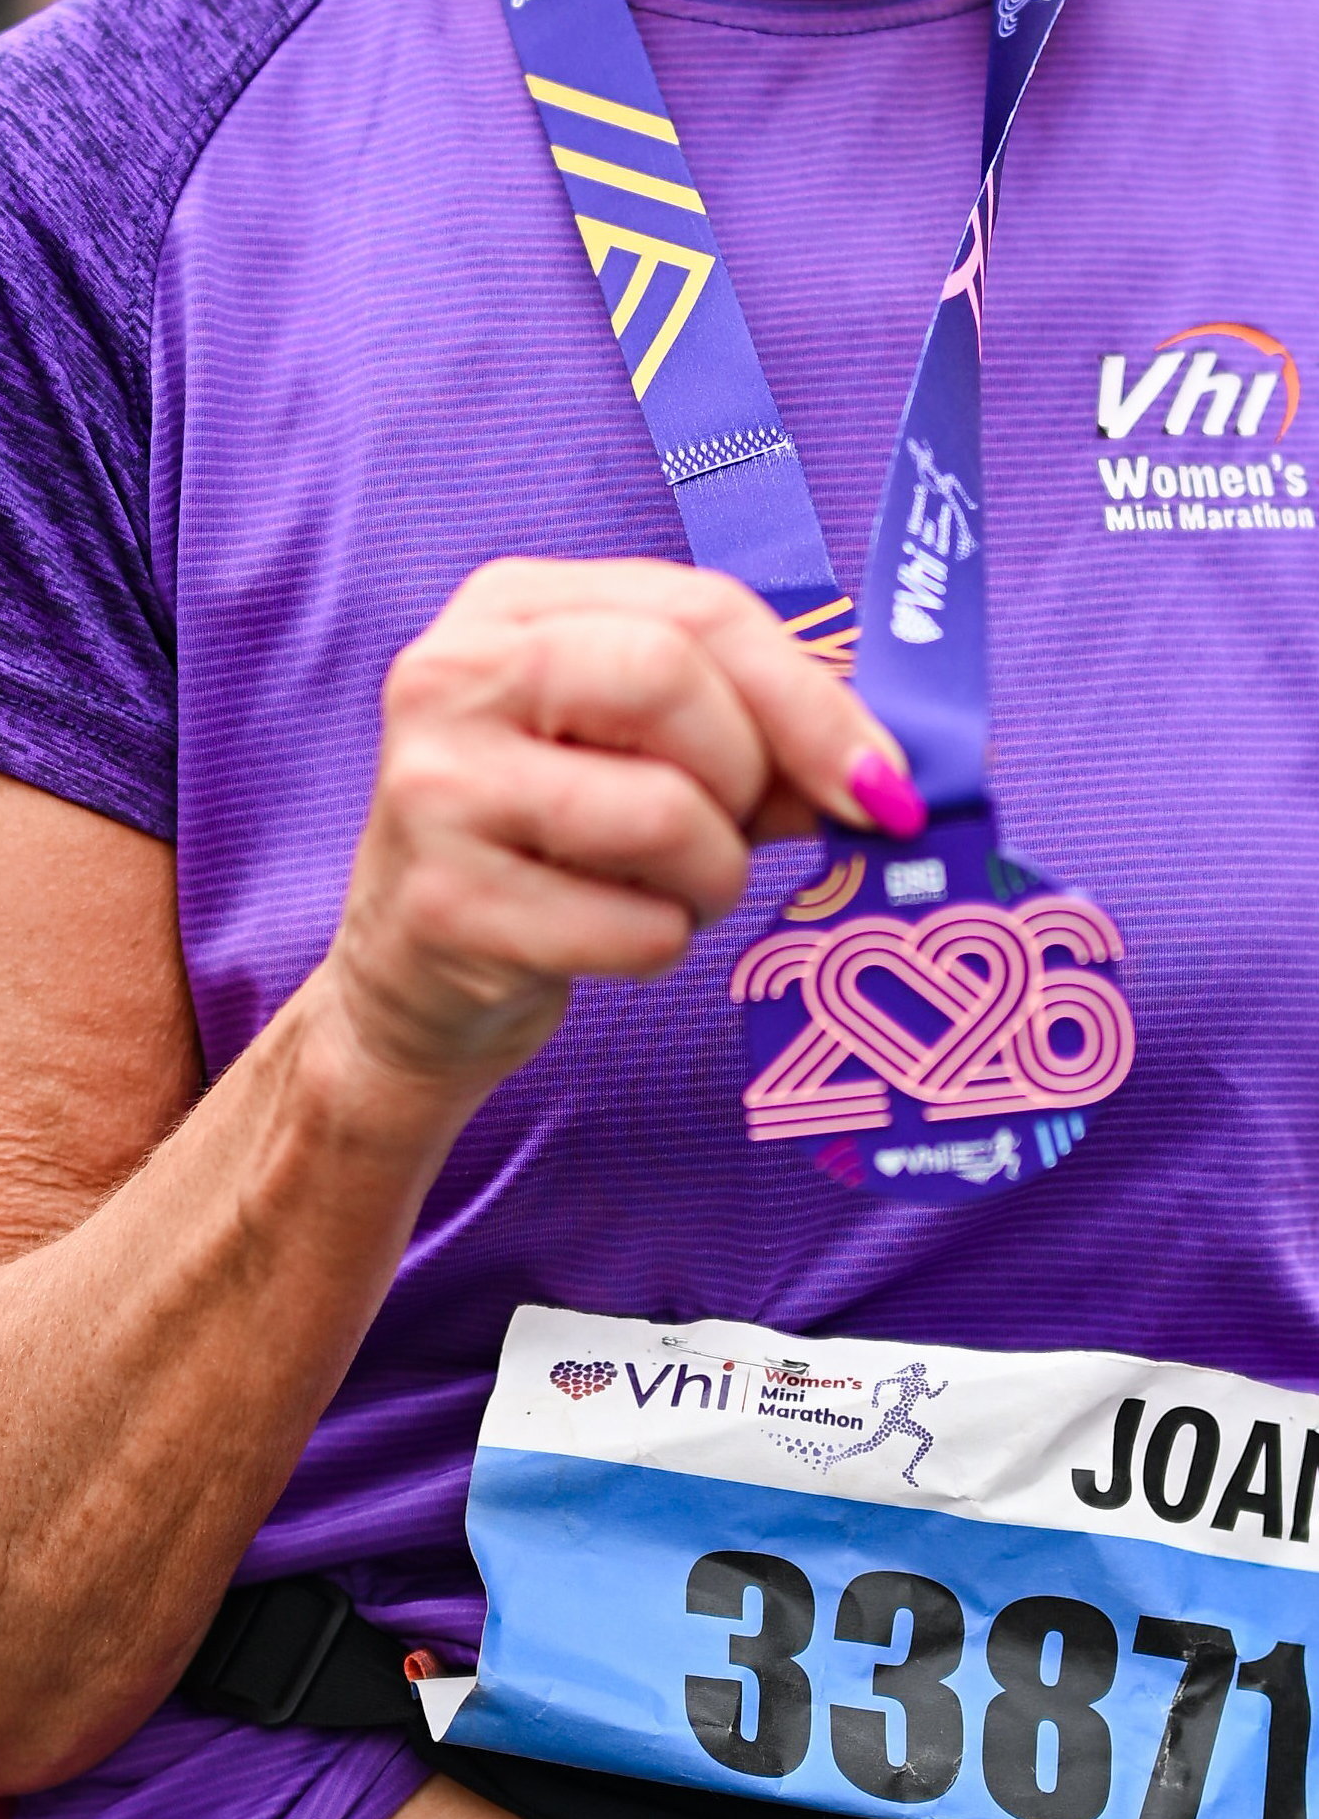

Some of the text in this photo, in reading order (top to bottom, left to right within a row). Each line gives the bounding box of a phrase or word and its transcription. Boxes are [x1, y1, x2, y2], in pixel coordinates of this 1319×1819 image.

[1096, 350, 1280, 439] Vhi
[1097, 453, 1309, 501] Women's
[1104, 501, 1315, 532] Mini Marathon
[624, 1359, 736, 1411] Vhi
[764, 1365, 864, 1391] Women's
[760, 1385, 806, 1404] Mini
[757, 1402, 865, 1431] Marathon
